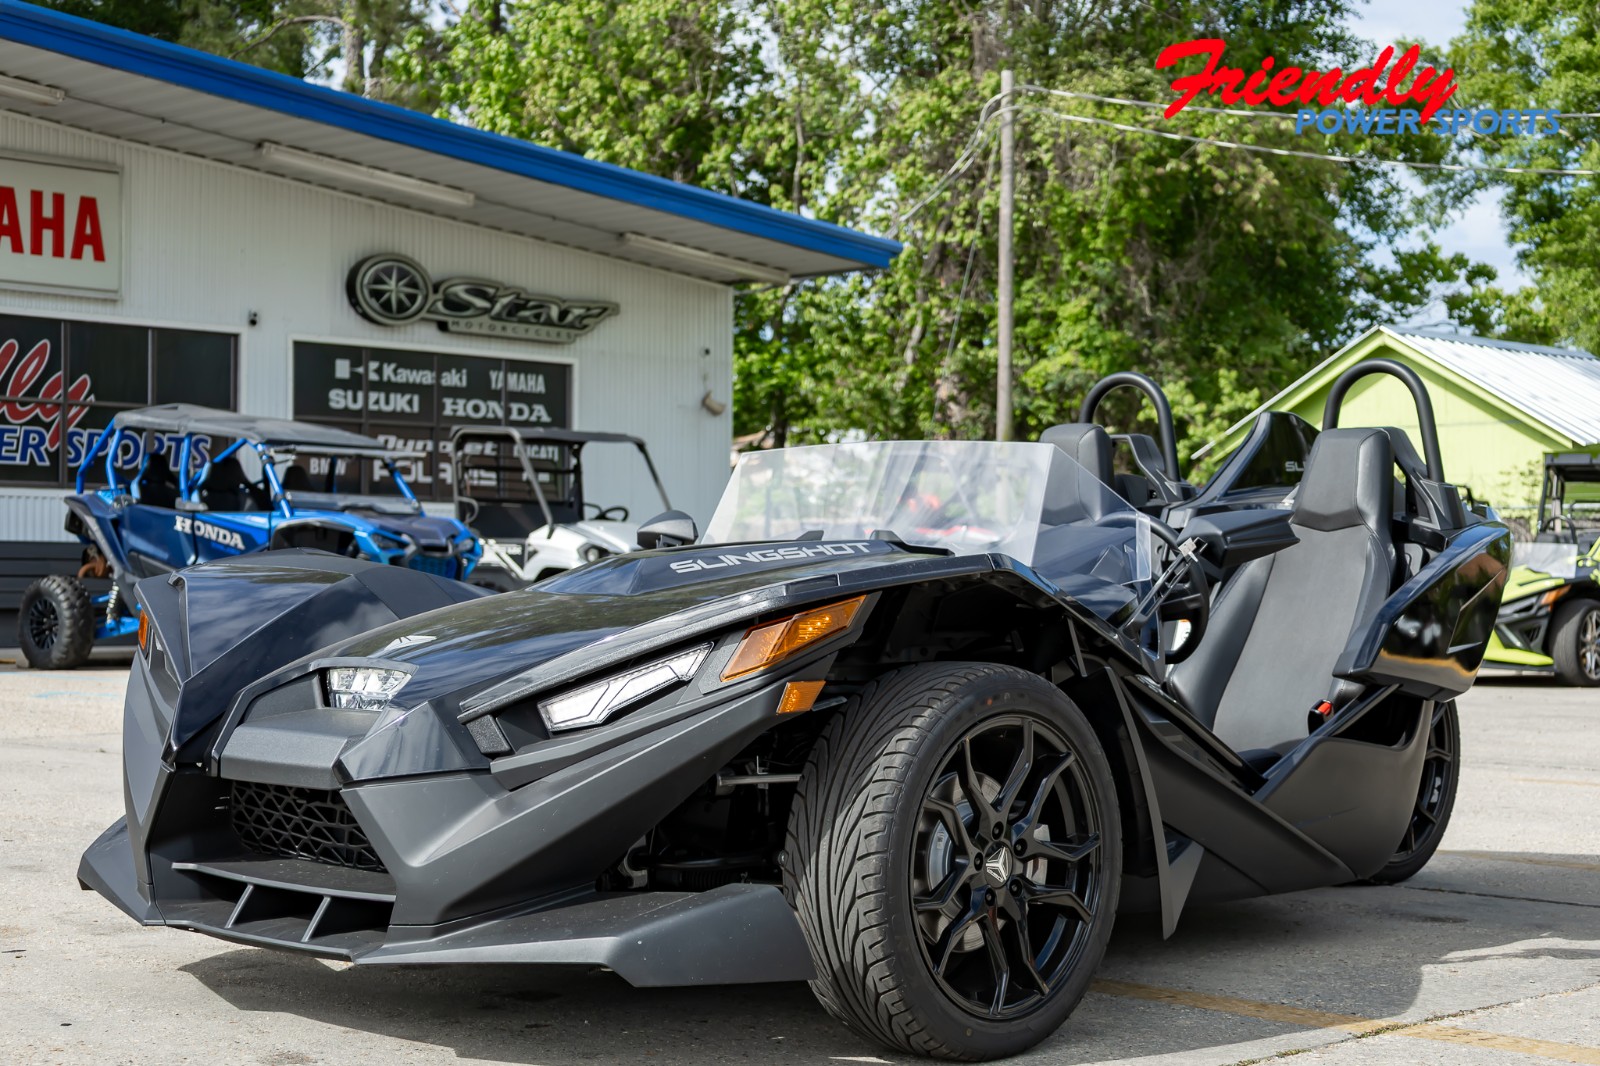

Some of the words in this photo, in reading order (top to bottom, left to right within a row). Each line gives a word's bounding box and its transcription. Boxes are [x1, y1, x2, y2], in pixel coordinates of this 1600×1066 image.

[436, 283, 612, 330] Star
[451, 319, 573, 340] MOTORCYCLES
[328, 388, 419, 414] SUZUKI
[442, 397, 552, 423] HONDA
[376, 434, 498, 456] Dynoet
[373, 459, 498, 487] POLAIS
[174, 515, 246, 550] HONDA
[669, 542, 872, 574] SLINGSHOT
